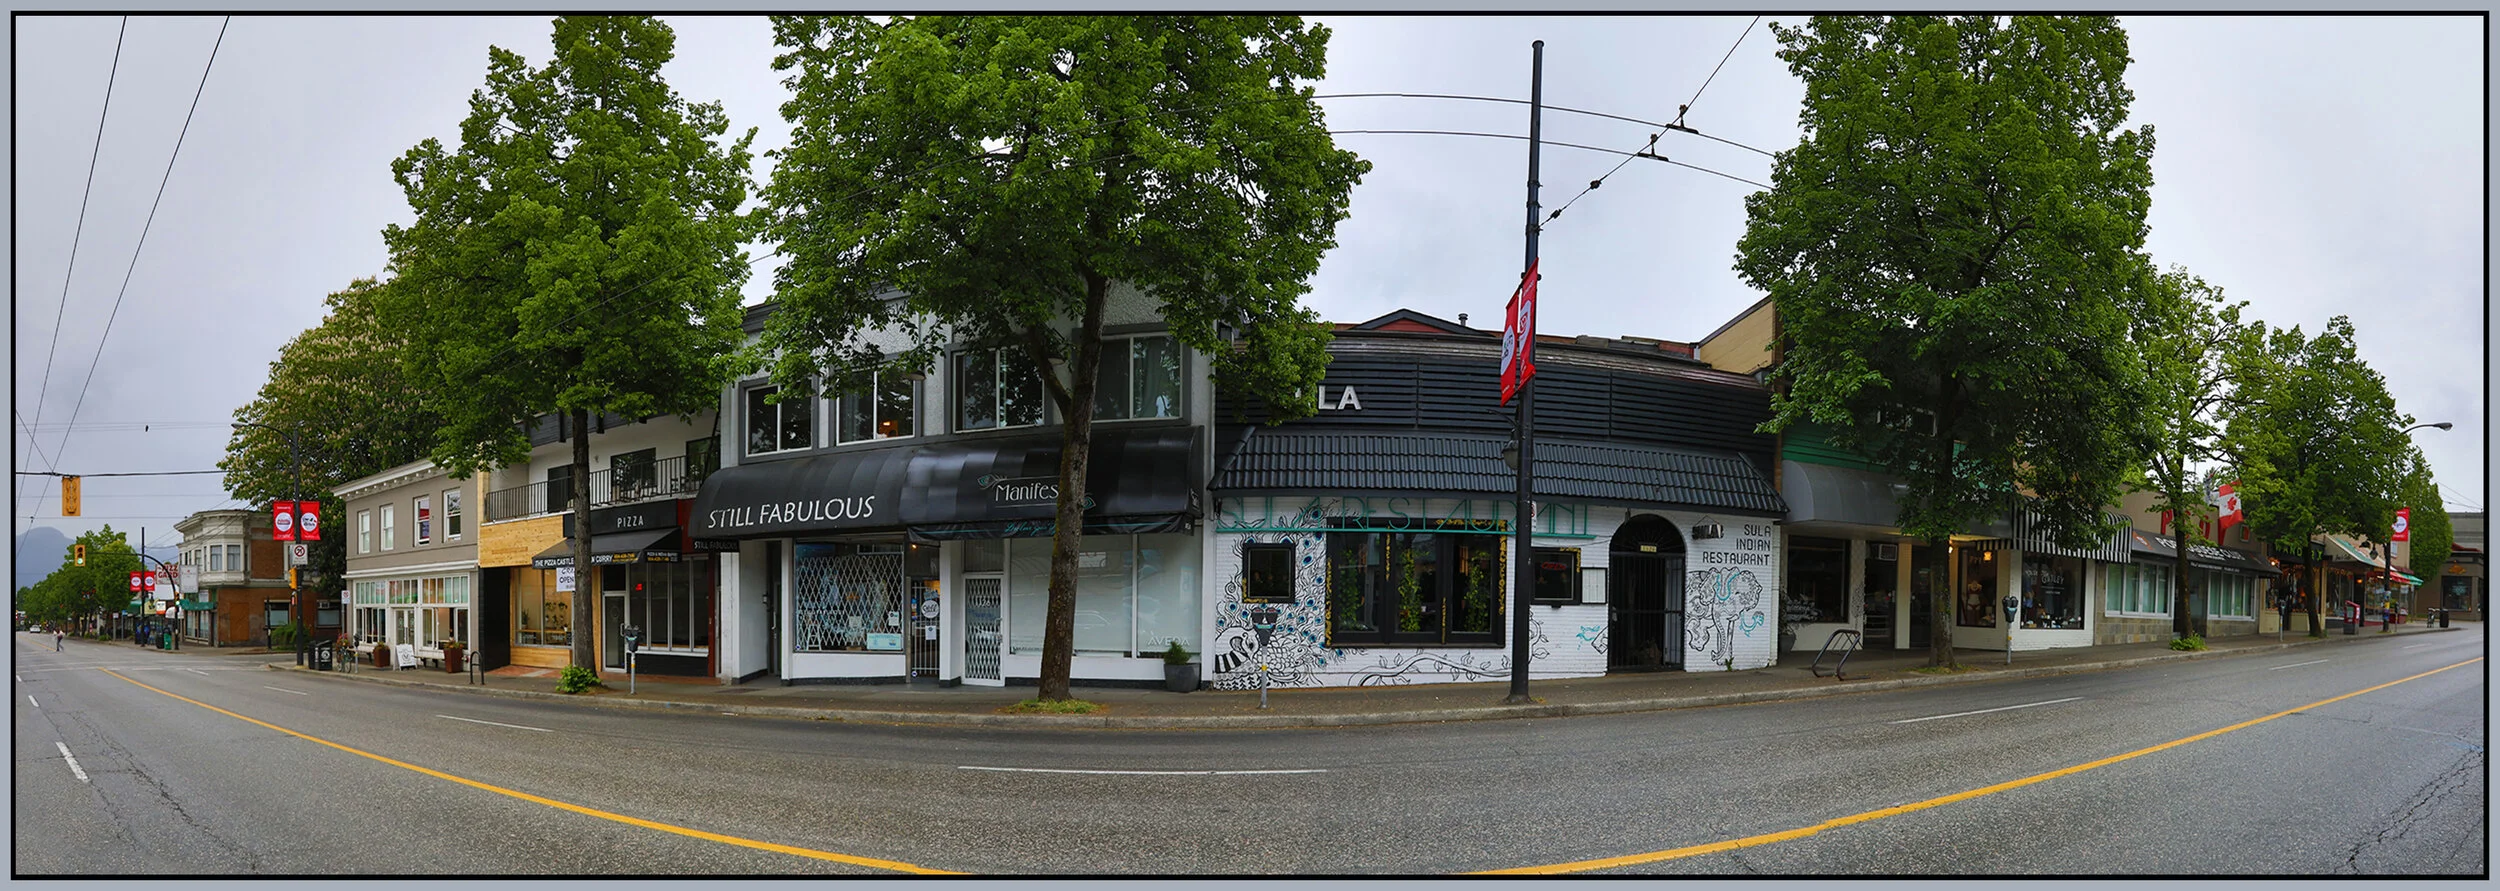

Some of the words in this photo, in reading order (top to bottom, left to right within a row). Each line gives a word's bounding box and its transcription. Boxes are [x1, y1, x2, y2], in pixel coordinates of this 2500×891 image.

[1318, 385, 1362, 411] LA
[995, 482, 1059, 502] Manifes
[708, 506, 754, 528] STILL
[759, 495, 875, 524] FABULOUS
[617, 515, 644, 528] PIZZA
[1744, 524, 1771, 537] SULA
[1736, 538, 1771, 552] INDIAN
[1702, 551, 1770, 566] RESTAURANT
[559, 576, 574, 584] OPEN
